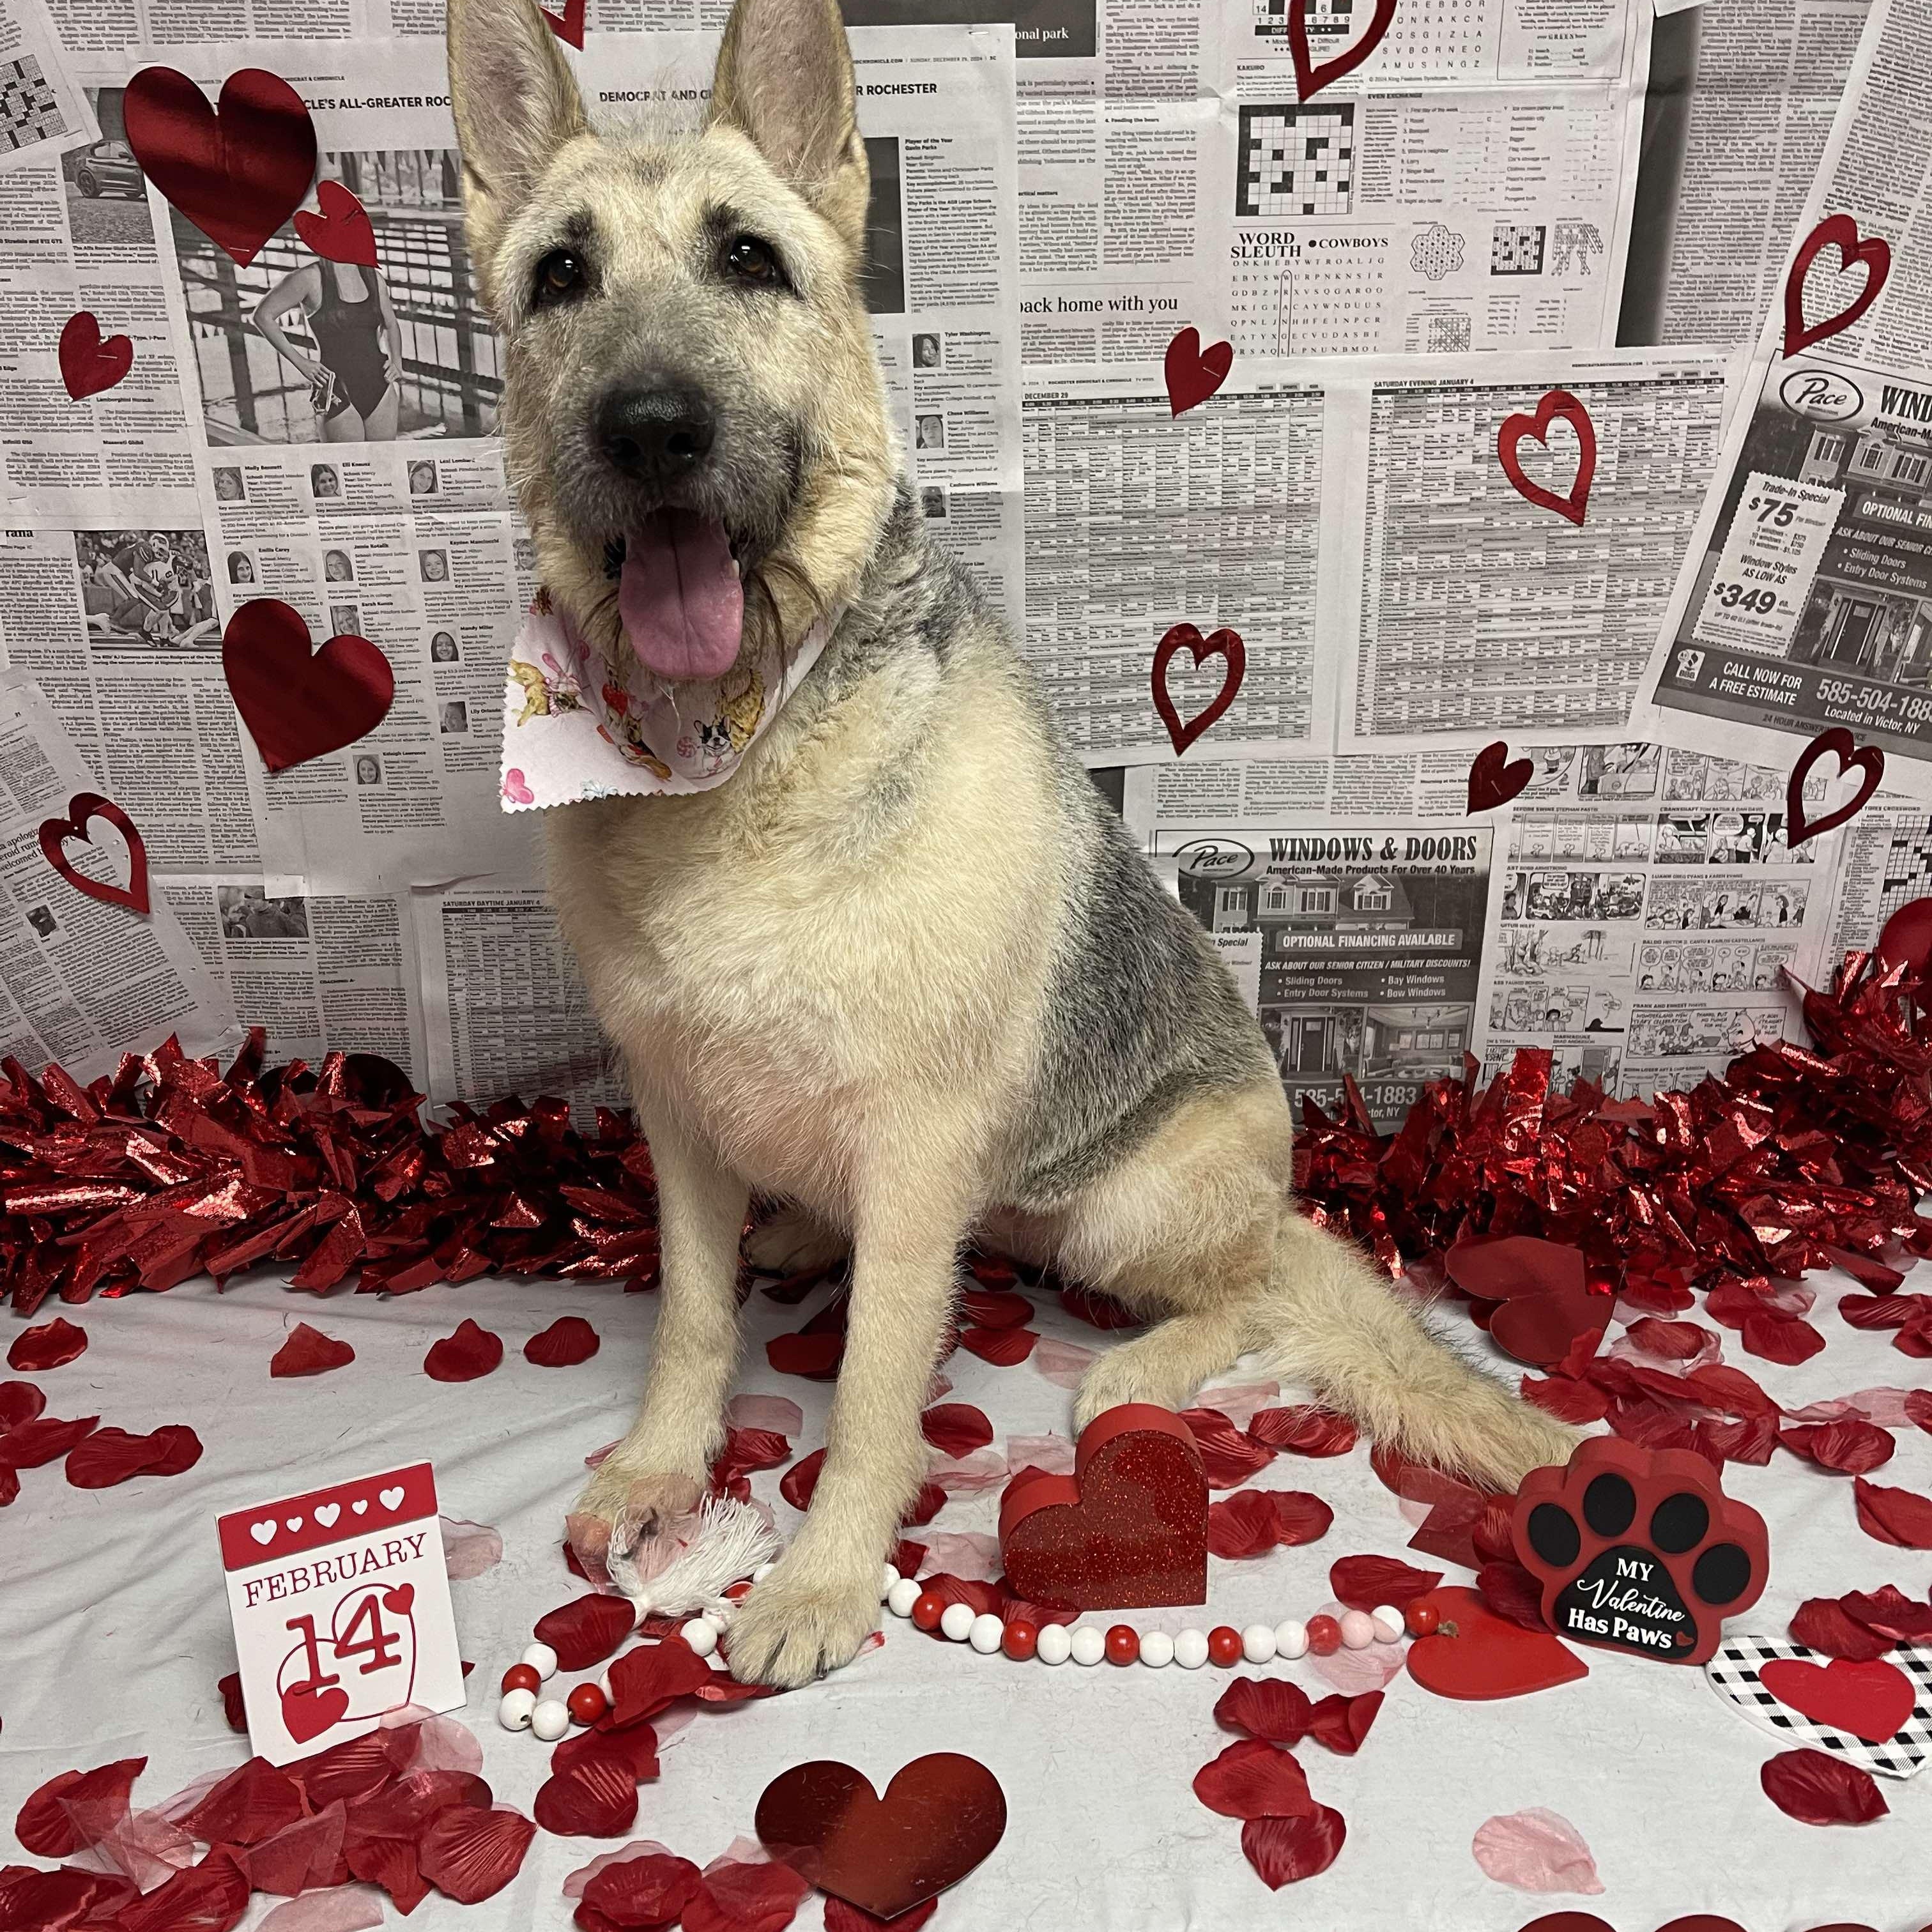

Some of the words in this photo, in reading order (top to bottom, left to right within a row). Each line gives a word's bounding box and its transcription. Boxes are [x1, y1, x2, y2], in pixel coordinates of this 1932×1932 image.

[1043, 27, 1069, 42] park
[671, 90, 696, 100] AND
[866, 83, 937, 95] ROCHESTER
[339, 96, 422, 109] ALL-GREATER
[1239, 233, 1295, 245] WORD
[1319, 238, 1388, 249] COWBOYS
[1230, 245, 1301, 259] SLEUTH
[1058, 297, 1103, 312] home
[1108, 296, 1143, 310] with
[1149, 298, 1177, 313] you
[1795, 378, 1847, 405] Pace
[1762, 482, 1797, 498] Trade-In
[1798, 489, 1830, 505] Special
[1749, 496, 1799, 526] $75
[1862, 501, 1912, 524] OPTIONAL
[1835, 526, 1854, 538] ASK
[1852, 529, 1880, 543] ABOUT
[1878, 535, 1896, 547] OUR
[1896, 539, 1924, 553] SENIOR
[1740, 554, 1772, 569] Window
[1774, 562, 1798, 574] Styles
[1850, 548, 1880, 565] Sliding
[1881, 555, 1906, 568] Doors
[1742, 569, 1754, 578] AS
[1756, 572, 1775, 582] LOW
[1774, 575, 1787, 585] AS
[1844, 562, 1866, 577] Entry
[1869, 568, 1889, 581] Door
[1890, 572, 1928, 590] Systems
[1713, 582, 1777, 614] $349
[1724, 661, 1750, 679] CALL
[1753, 667, 1781, 684] NOW
[1781, 674, 1802, 690] FOR
[1709, 677, 1717, 689] A
[1719, 680, 1746, 695] FREE
[1747, 684, 1797, 706] ESTIMATE
[1816, 678, 1932, 721] 585-504-188
[1774, 715, 1794, 728] HOUR
[1825, 705, 1863, 723] Located
[1863, 714, 1873, 724] in
[1874, 715, 1903, 733] Victor,
[1905, 721, 1920, 734] NY
[1190, 845, 1239, 870] Pace
[1269, 837, 1373, 862] WINDOWS
[1380, 837, 1398, 861] &
[1405, 836, 1476, 861] DOORS
[1266, 866, 1342, 875] American-Made
[1345, 865, 1388, 875] Products
[1391, 865, 1407, 874] For
[1410, 864, 1432, 874] Over
[1435, 864, 1446, 874] 40
[1450, 864, 1475, 874] Years
[1218, 938, 1248, 947] Special
[1283, 937, 1335, 948] OPTIONAL
[1338, 935, 1396, 947] FINANCING
[1398, 933, 1455, 947] AVAILABLE
[1265, 961, 1281, 970] ASK
[1282, 961, 1308, 970] ABOUT
[1309, 961, 1325, 970] OUR
[1327, 960, 1354, 969] SENIOR
[1356, 960, 1383, 969] CITIZEN
[1391, 960, 1425, 969] MILITARY
[1425, 959, 1470, 968] DISCOUNTS!
[1285, 976, 1315, 986] Sliding
[1317, 976, 1342, 985] Doors
[1388, 976, 1404, 985] Bay
[1406, 975, 1445, 984] Windows
[1284, 988, 1306, 999] Entry
[1308, 988, 1330, 997] Door
[1331, 989, 1368, 999] Systems
[1387, 988, 1405, 998] Bow
[1407, 988, 1446, 997] Windows
[1386, 1107, 1400, 1117] NY
[243, 1532, 427, 1608] FEBRUARY
[1616, 1558, 1654, 1582] MY
[1577, 1577, 1685, 1623] Valentine
[1568, 1608, 1609, 1635] Has
[1613, 1617, 1673, 1650] Paws
[286, 1594, 402, 1696] 14
